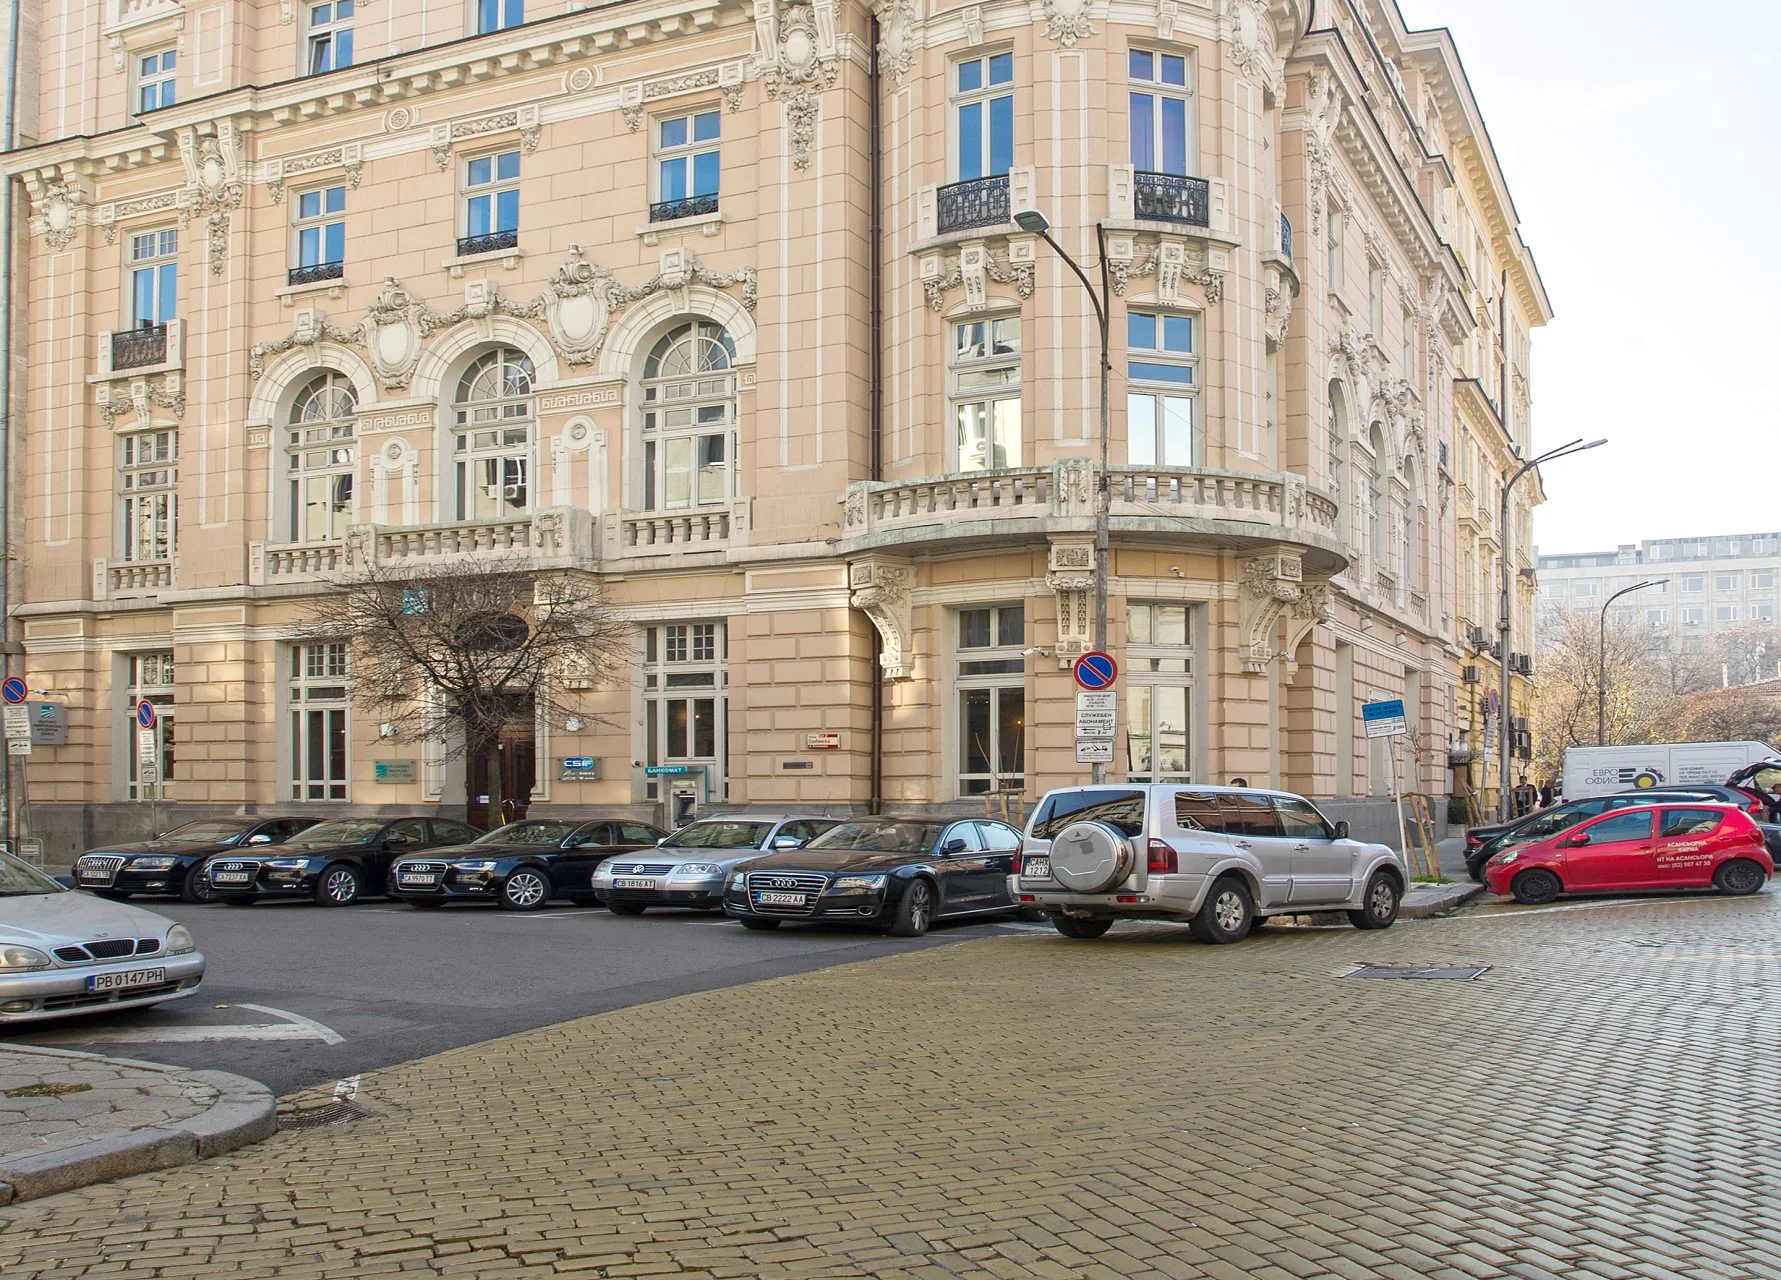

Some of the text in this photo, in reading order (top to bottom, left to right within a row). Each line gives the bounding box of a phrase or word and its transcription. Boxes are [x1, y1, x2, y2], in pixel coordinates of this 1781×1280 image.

[97, 970, 163, 989] PB 0147 PH
